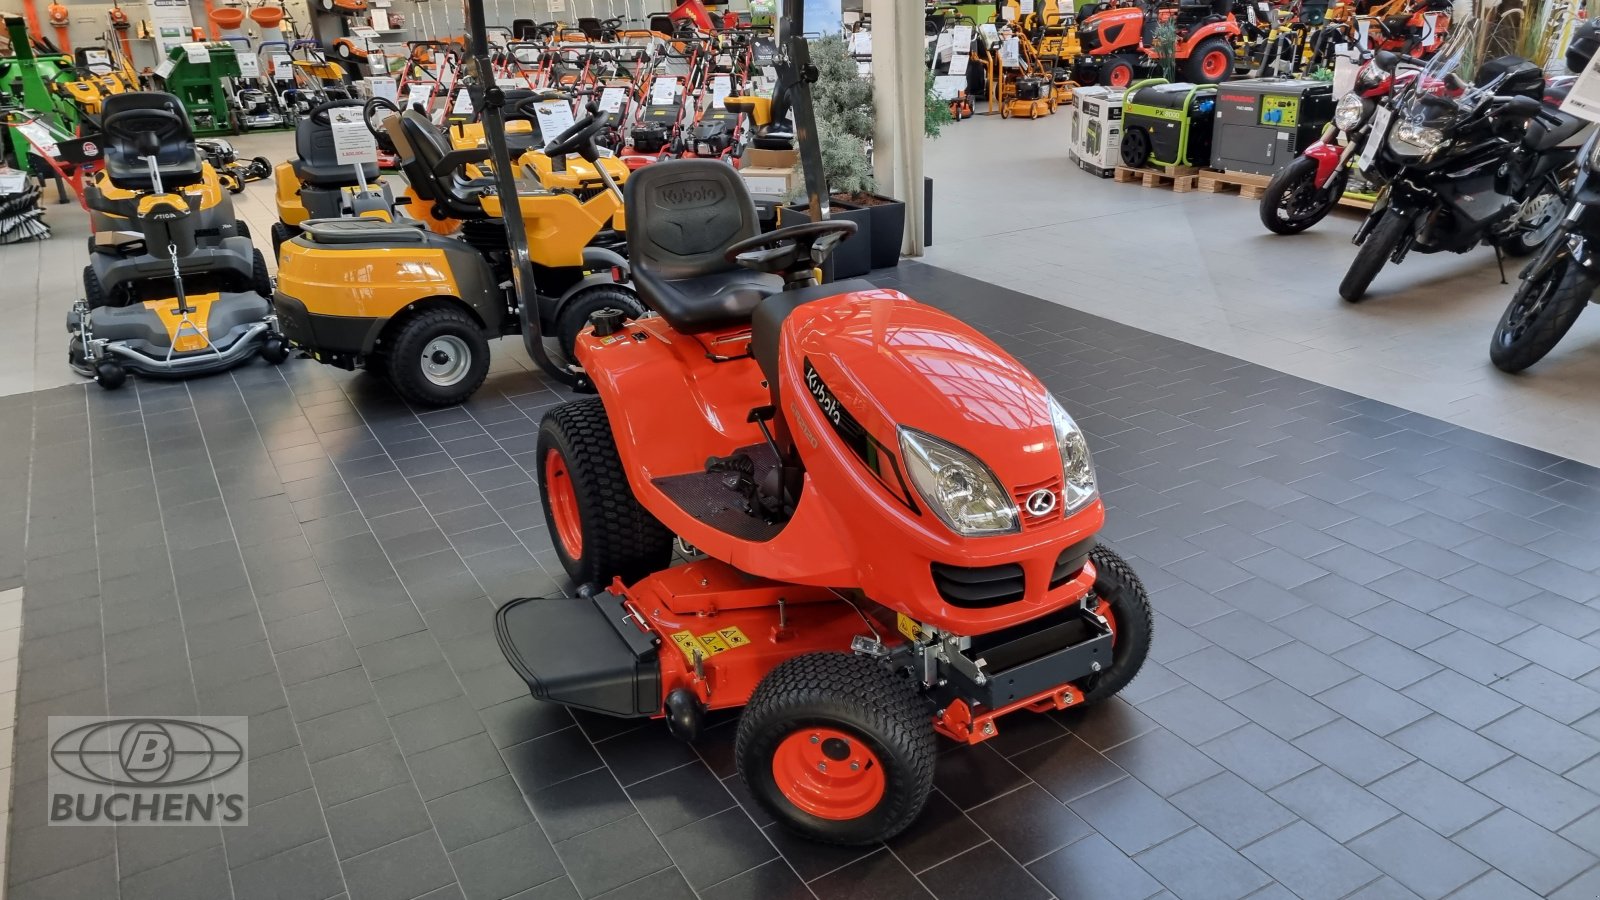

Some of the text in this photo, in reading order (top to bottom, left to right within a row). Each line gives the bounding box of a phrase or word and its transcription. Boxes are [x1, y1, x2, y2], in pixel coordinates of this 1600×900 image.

[1164, 111, 1180, 119] 8000
[662, 186, 717, 204] Kubota
[806, 367, 841, 425] Kubota
